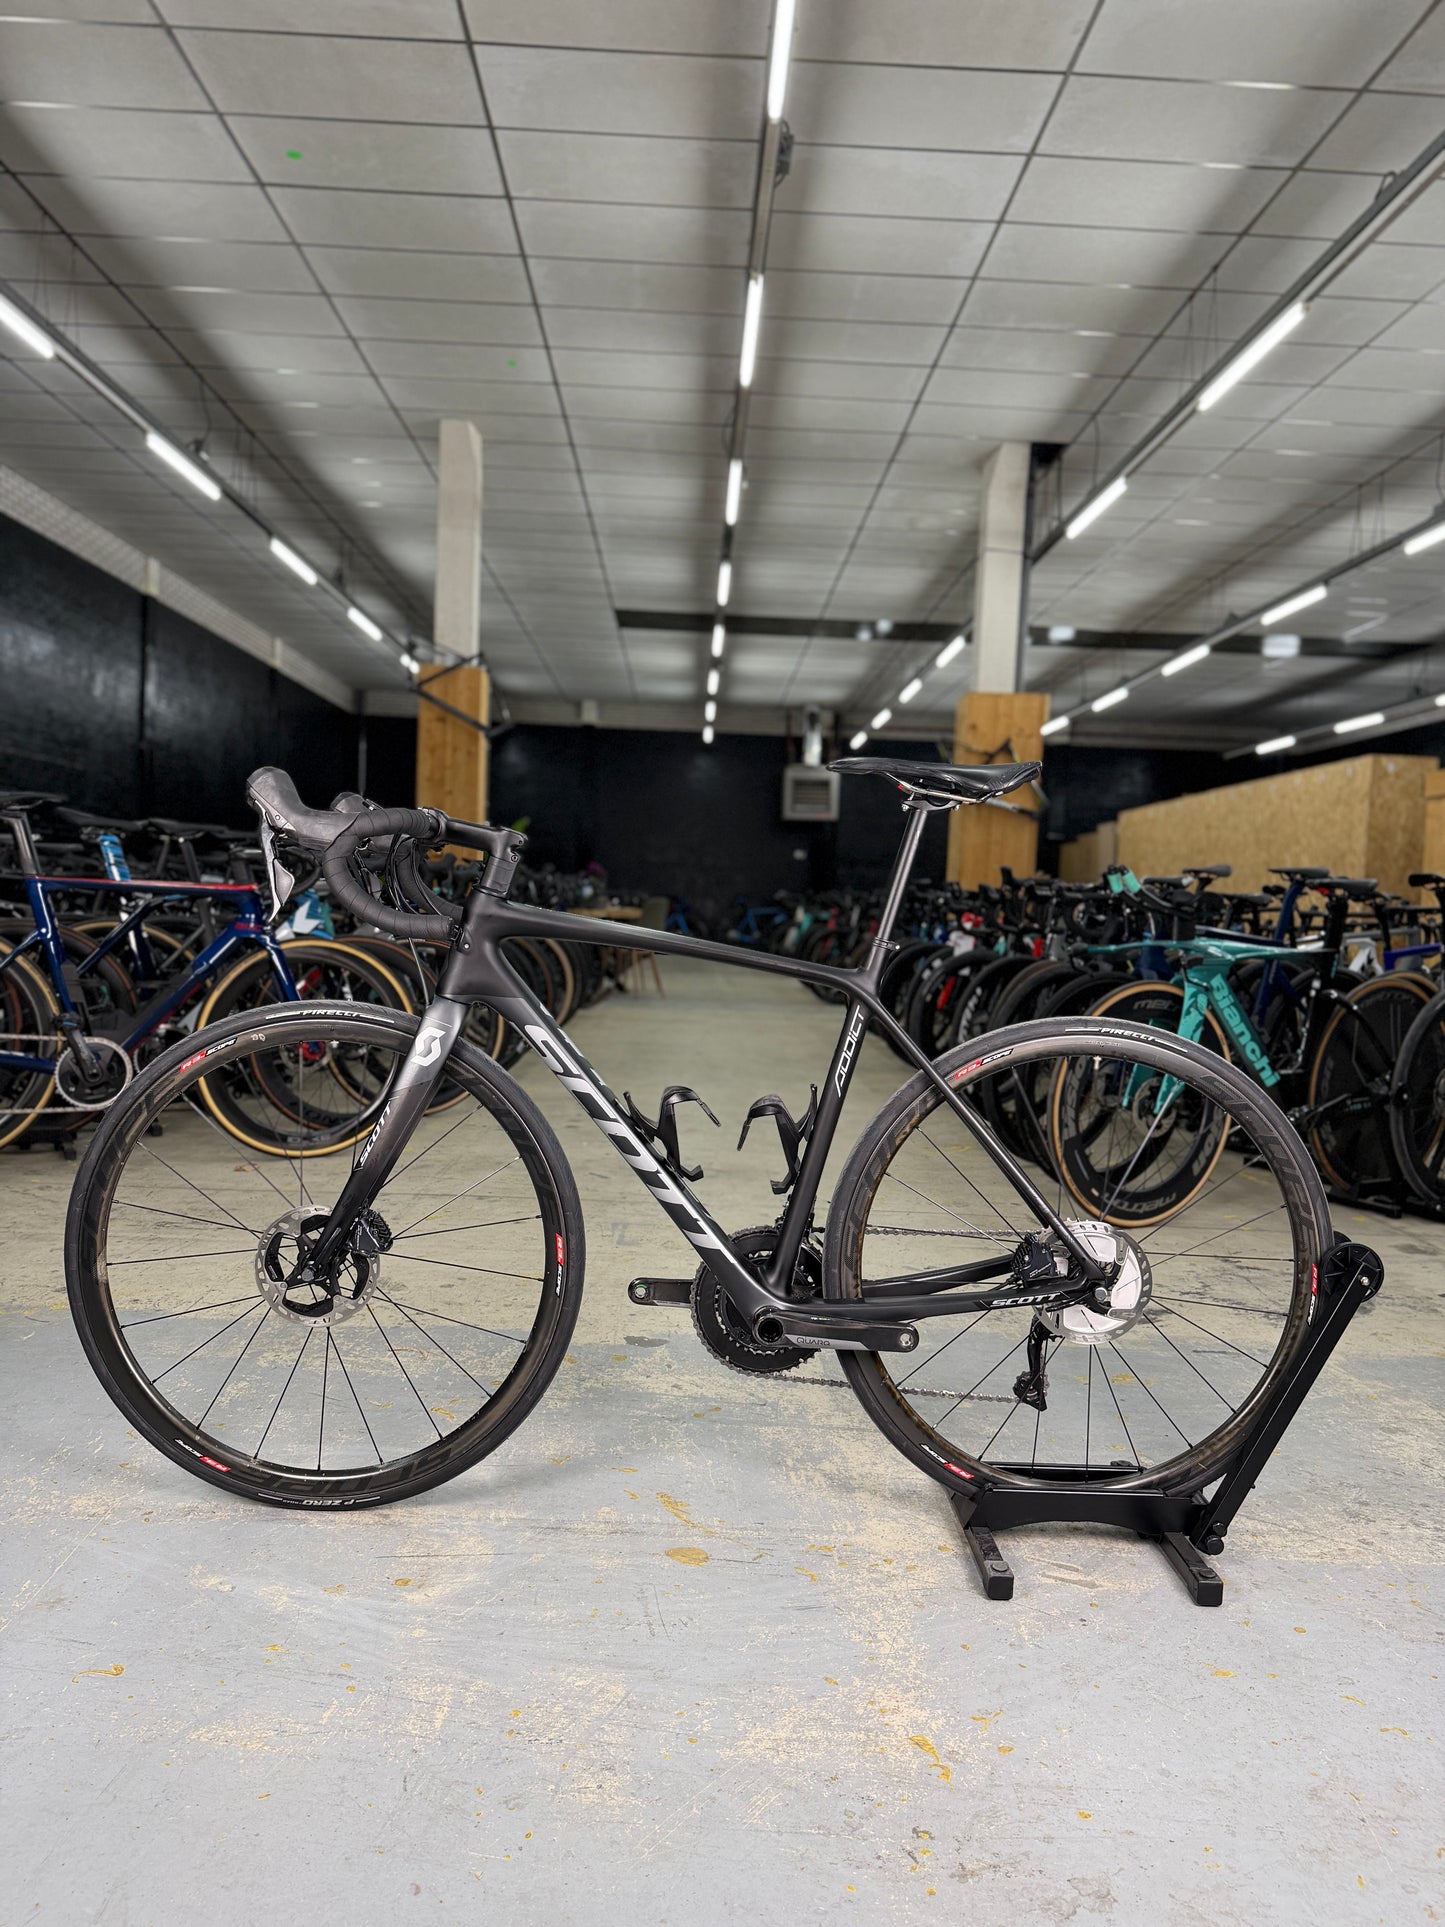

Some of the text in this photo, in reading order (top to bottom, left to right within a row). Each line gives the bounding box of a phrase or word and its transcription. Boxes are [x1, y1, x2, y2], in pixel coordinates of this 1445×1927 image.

[301, 1009, 359, 1018] PIRELLI
[1100, 1027, 1157, 1042] PIRELLI
[1210, 973, 1281, 1089] Bianchi
[206, 1039, 236, 1056] SCOPE
[982, 1049, 1013, 1065] SCOPE
[359, 1101, 391, 1168] SCOTT
[524, 1024, 737, 1265] SCOTT
[555, 1263, 563, 1297] SCOPE
[990, 1292, 1061, 1307] SCOTT
[1307, 1293, 1316, 1326] SCOPE
[796, 1336, 831, 1348] QUARQ
[174, 1439, 203, 1458] SCOPE
[920, 1444, 949, 1464] SCOPE
